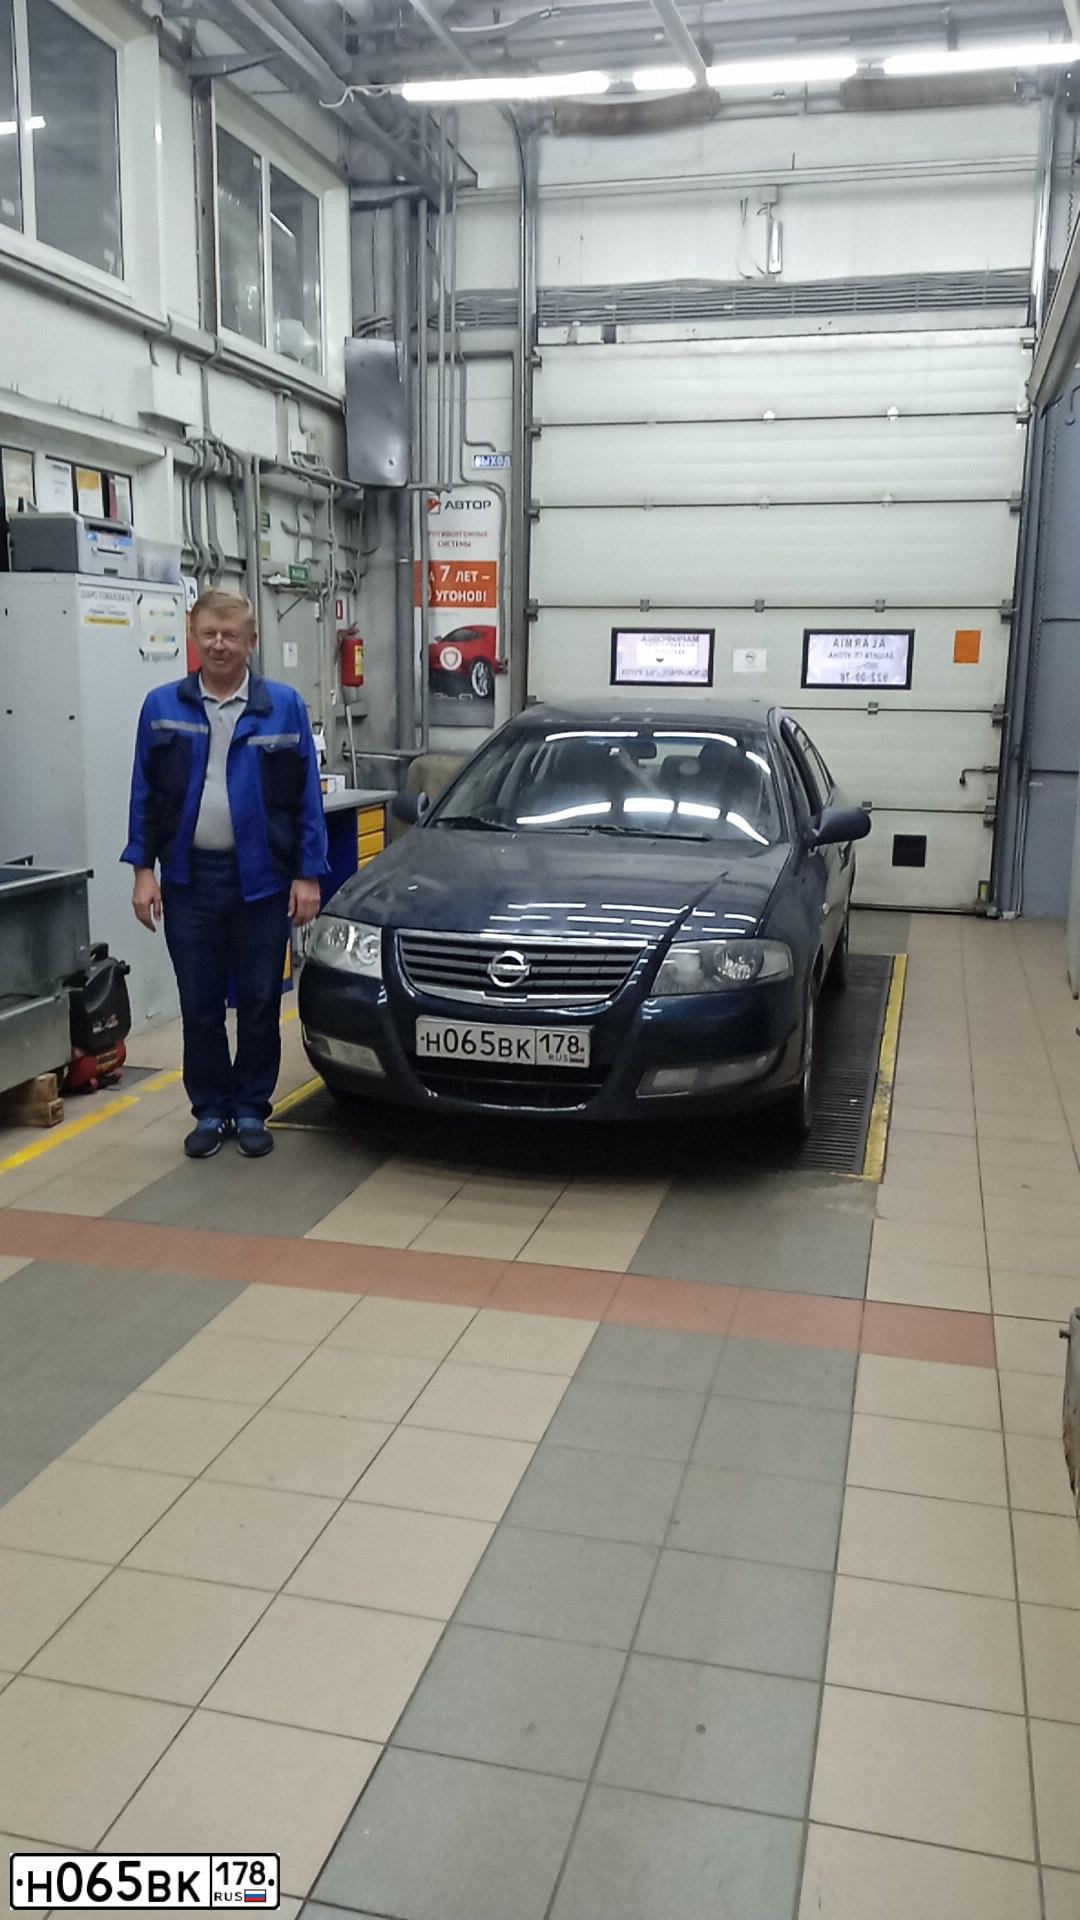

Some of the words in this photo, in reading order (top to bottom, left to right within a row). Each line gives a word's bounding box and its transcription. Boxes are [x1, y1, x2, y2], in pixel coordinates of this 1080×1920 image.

[444, 500, 492, 510] АВТОР
[439, 565, 451, 582] 7
[455, 571, 479, 583] ЛЕТ
[435, 590, 487, 602] УГОНОВ!
[426, 1028, 531, 1060] Н065ВК
[539, 1033, 580, 1055] 178
[549, 1053, 569, 1063] RUS
